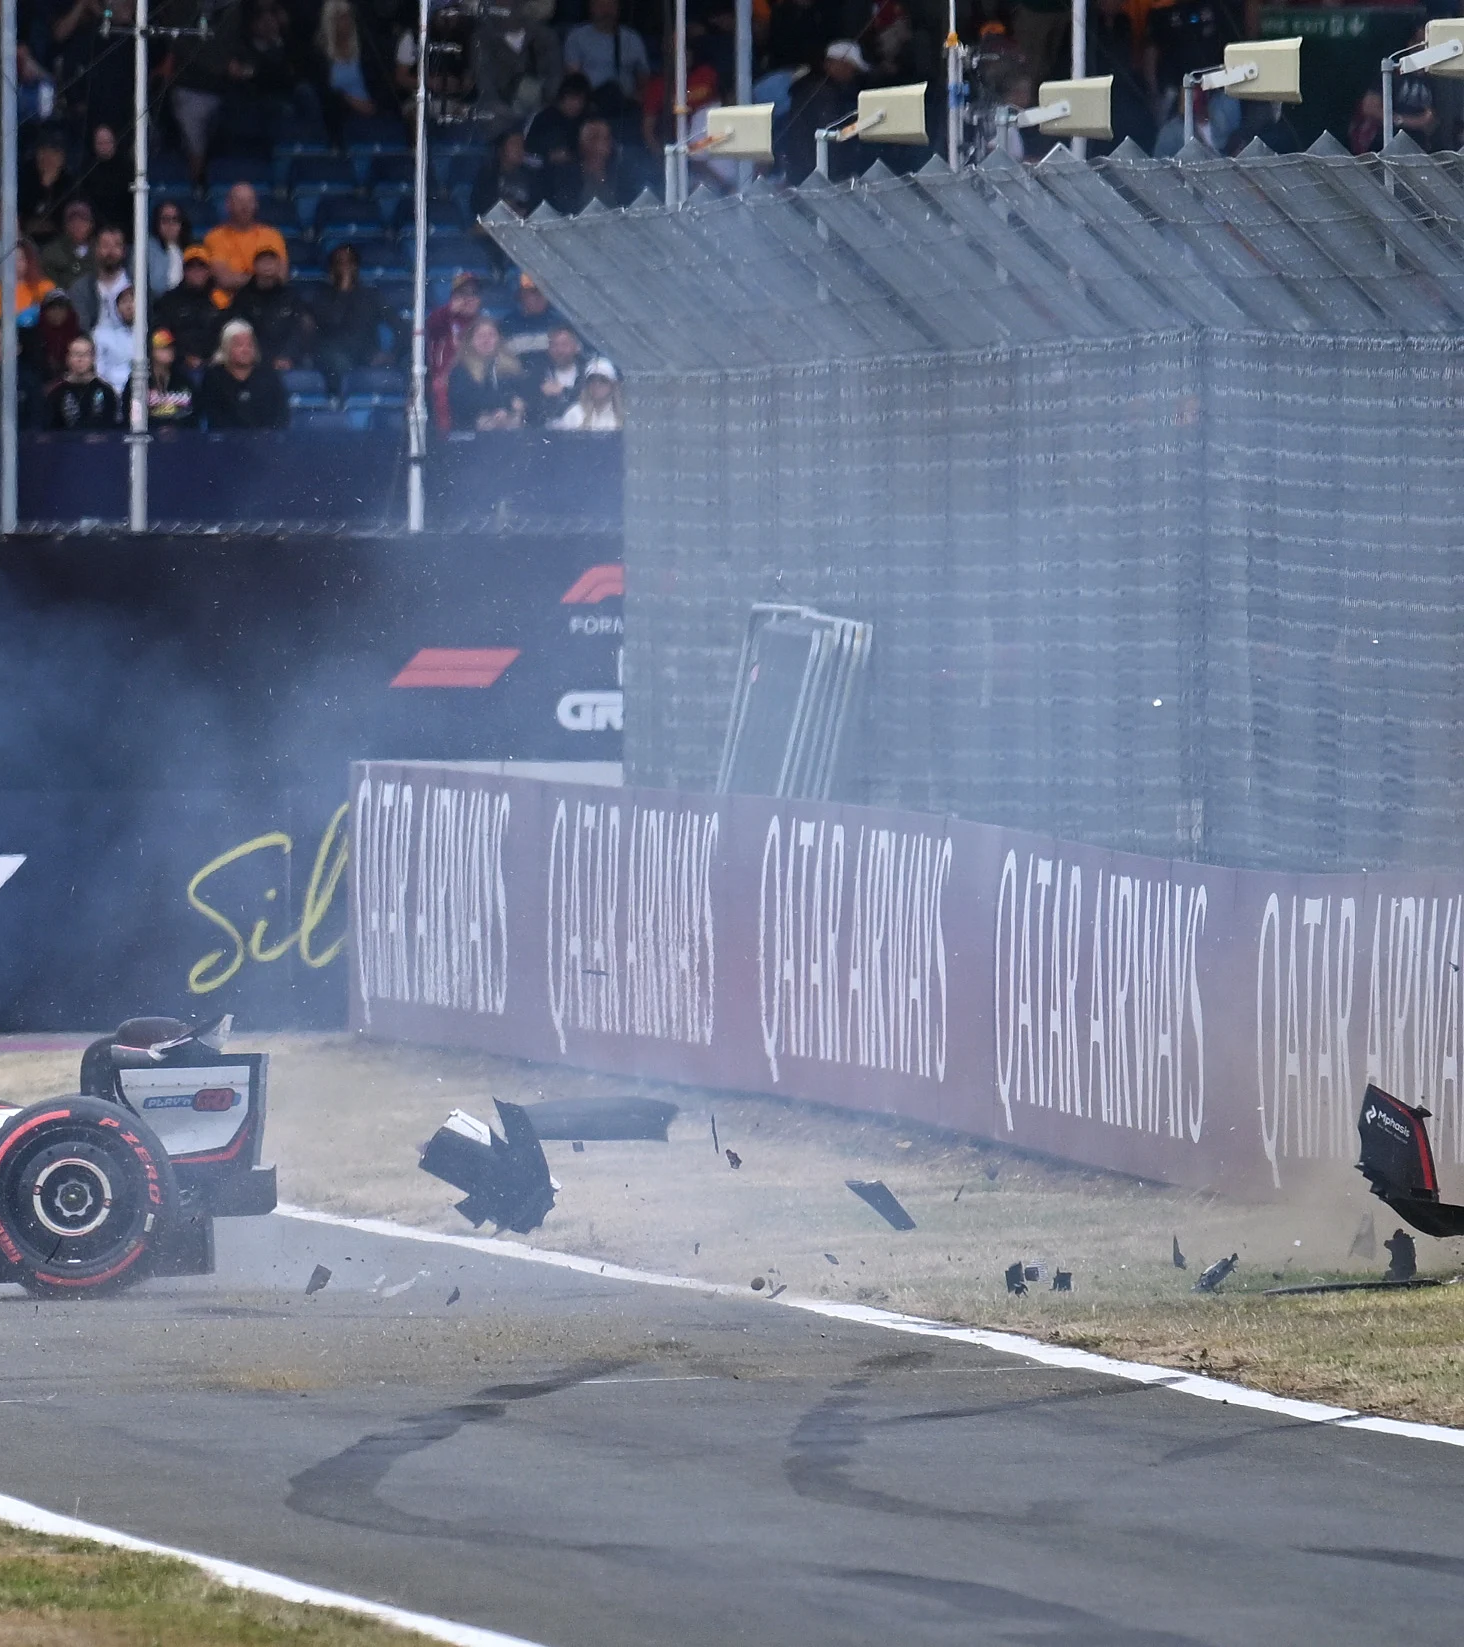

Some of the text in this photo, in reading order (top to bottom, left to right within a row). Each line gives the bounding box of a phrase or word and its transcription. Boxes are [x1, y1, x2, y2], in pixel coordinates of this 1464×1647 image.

[547, 799, 622, 1055] QATAR
[759, 814, 953, 1083] QATAR AIRWAYS
[995, 848, 1208, 1144] QATAR AIRWAYS
[1256, 892, 1357, 1189] QATAR
[1377, 1110, 1411, 1138] Mphasis
